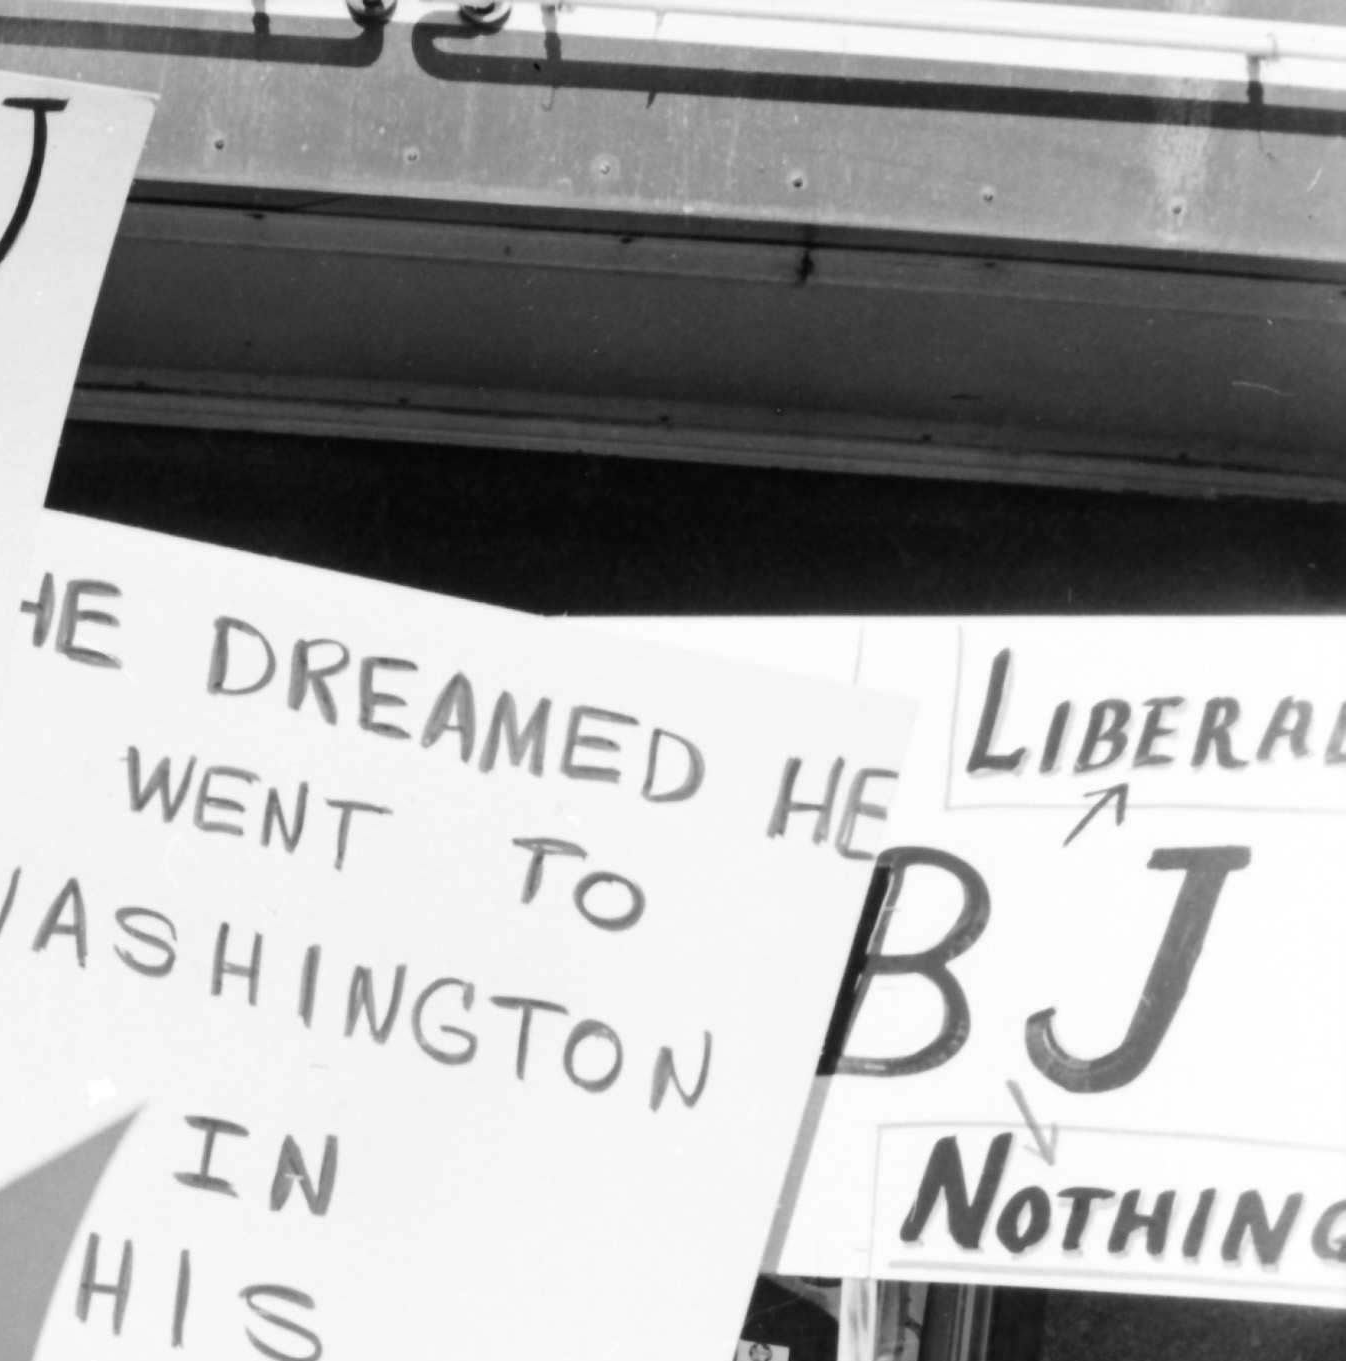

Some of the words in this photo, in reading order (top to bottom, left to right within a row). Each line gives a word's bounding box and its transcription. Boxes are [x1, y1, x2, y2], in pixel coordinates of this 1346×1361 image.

[209, 616, 705, 802] DREAMED
[766, 757, 900, 861] HE
[120, 746, 392, 870] WENT
[512, 838, 646, 931] TO
[173, 1114, 338, 1216] IN
